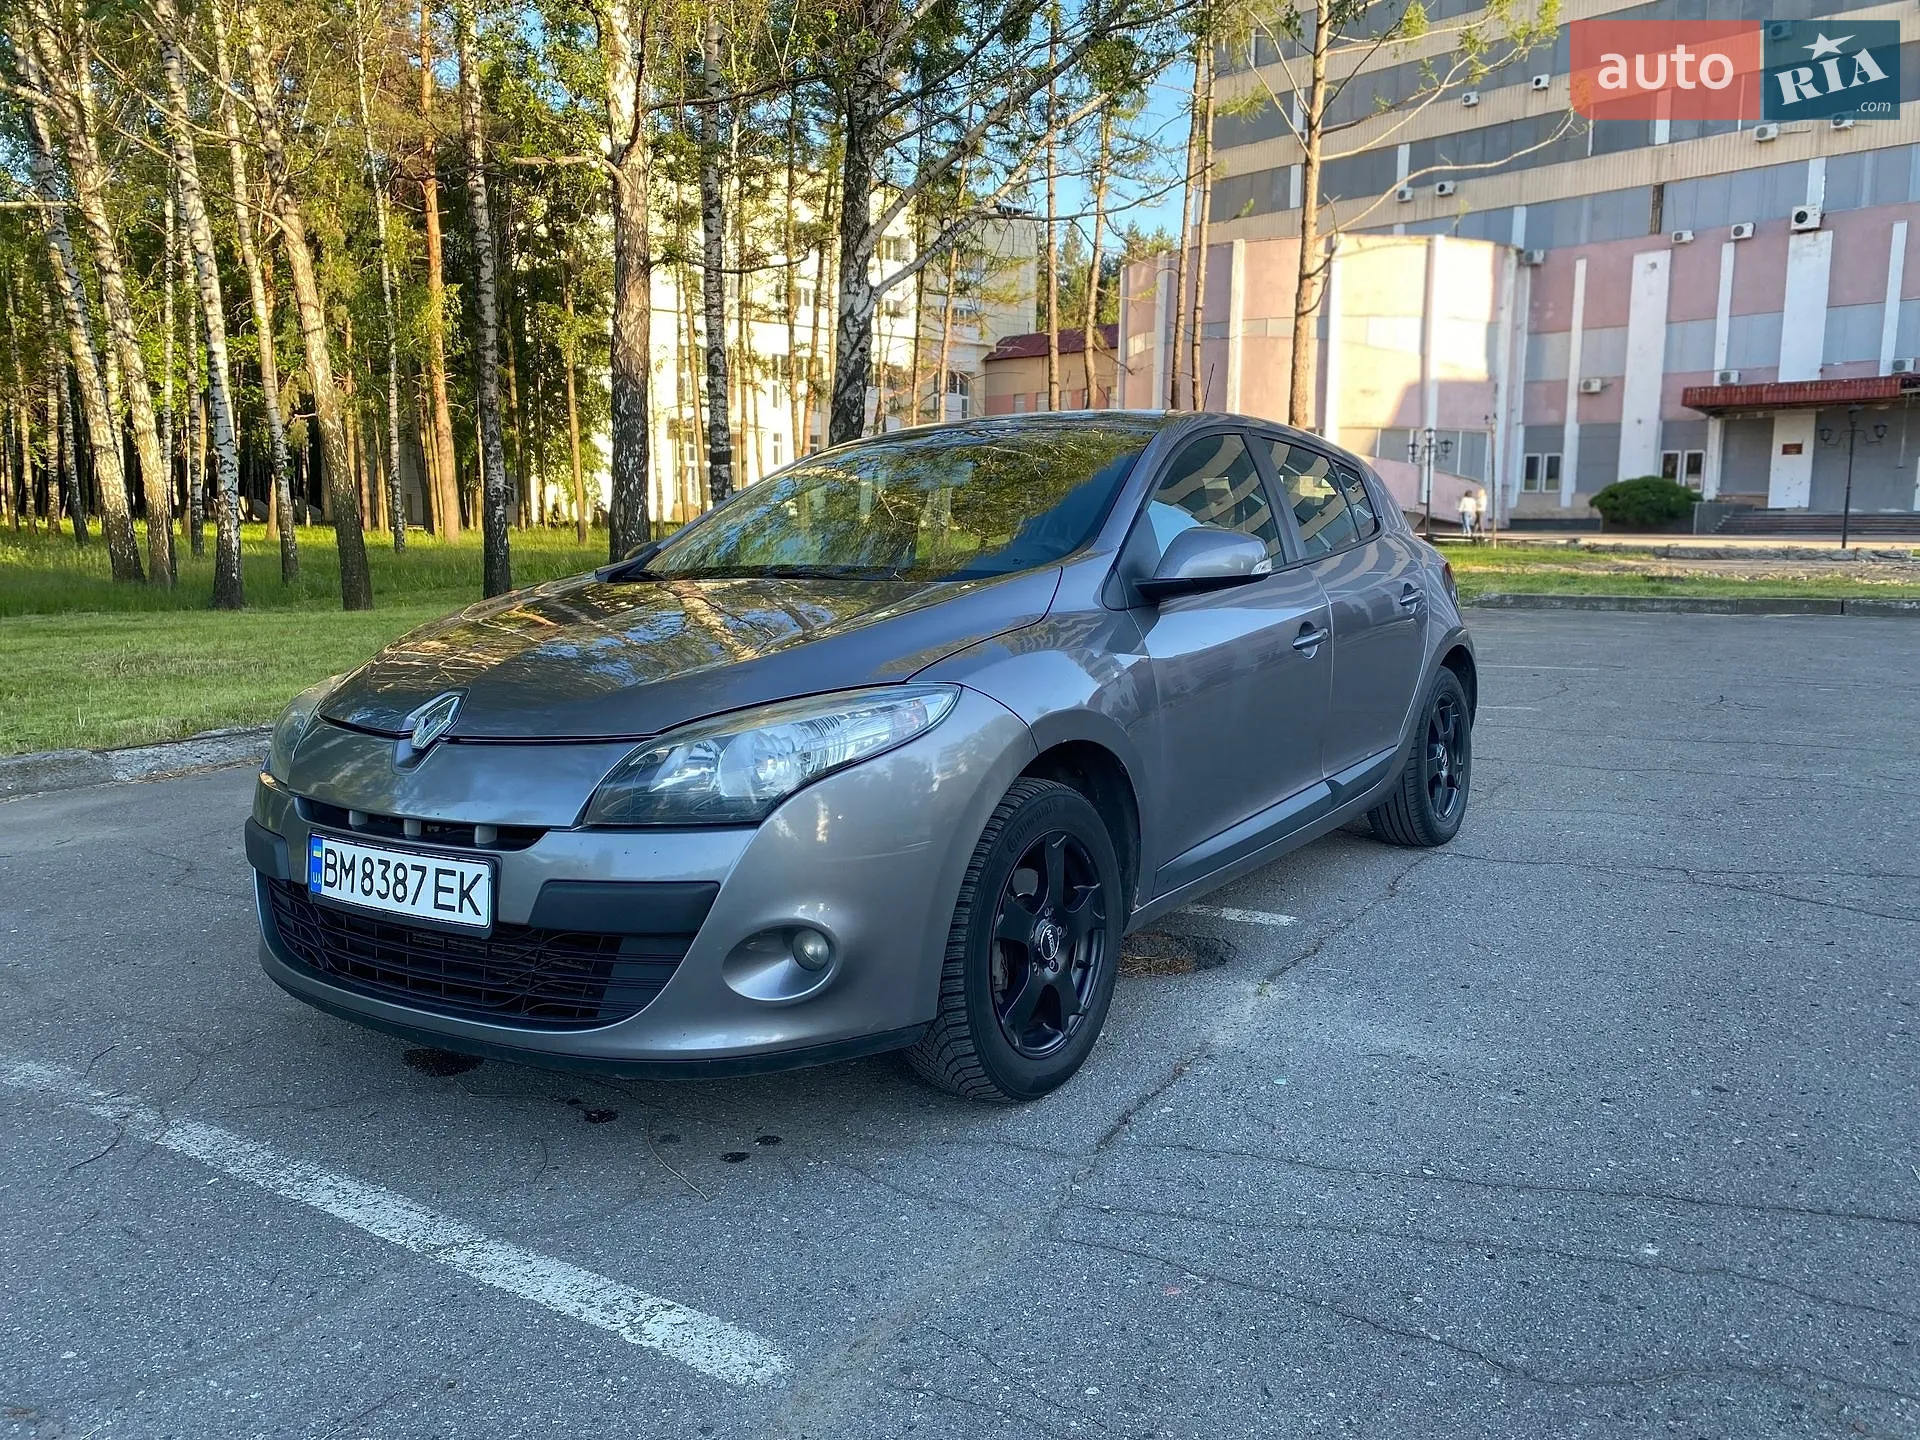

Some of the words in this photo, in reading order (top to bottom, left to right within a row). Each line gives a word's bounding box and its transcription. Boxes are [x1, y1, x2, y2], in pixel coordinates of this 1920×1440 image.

[312, 871, 322, 885] UA
[323, 847, 356, 894] BM
[360, 856, 427, 906] 8387
[433, 867, 483, 917] EK
